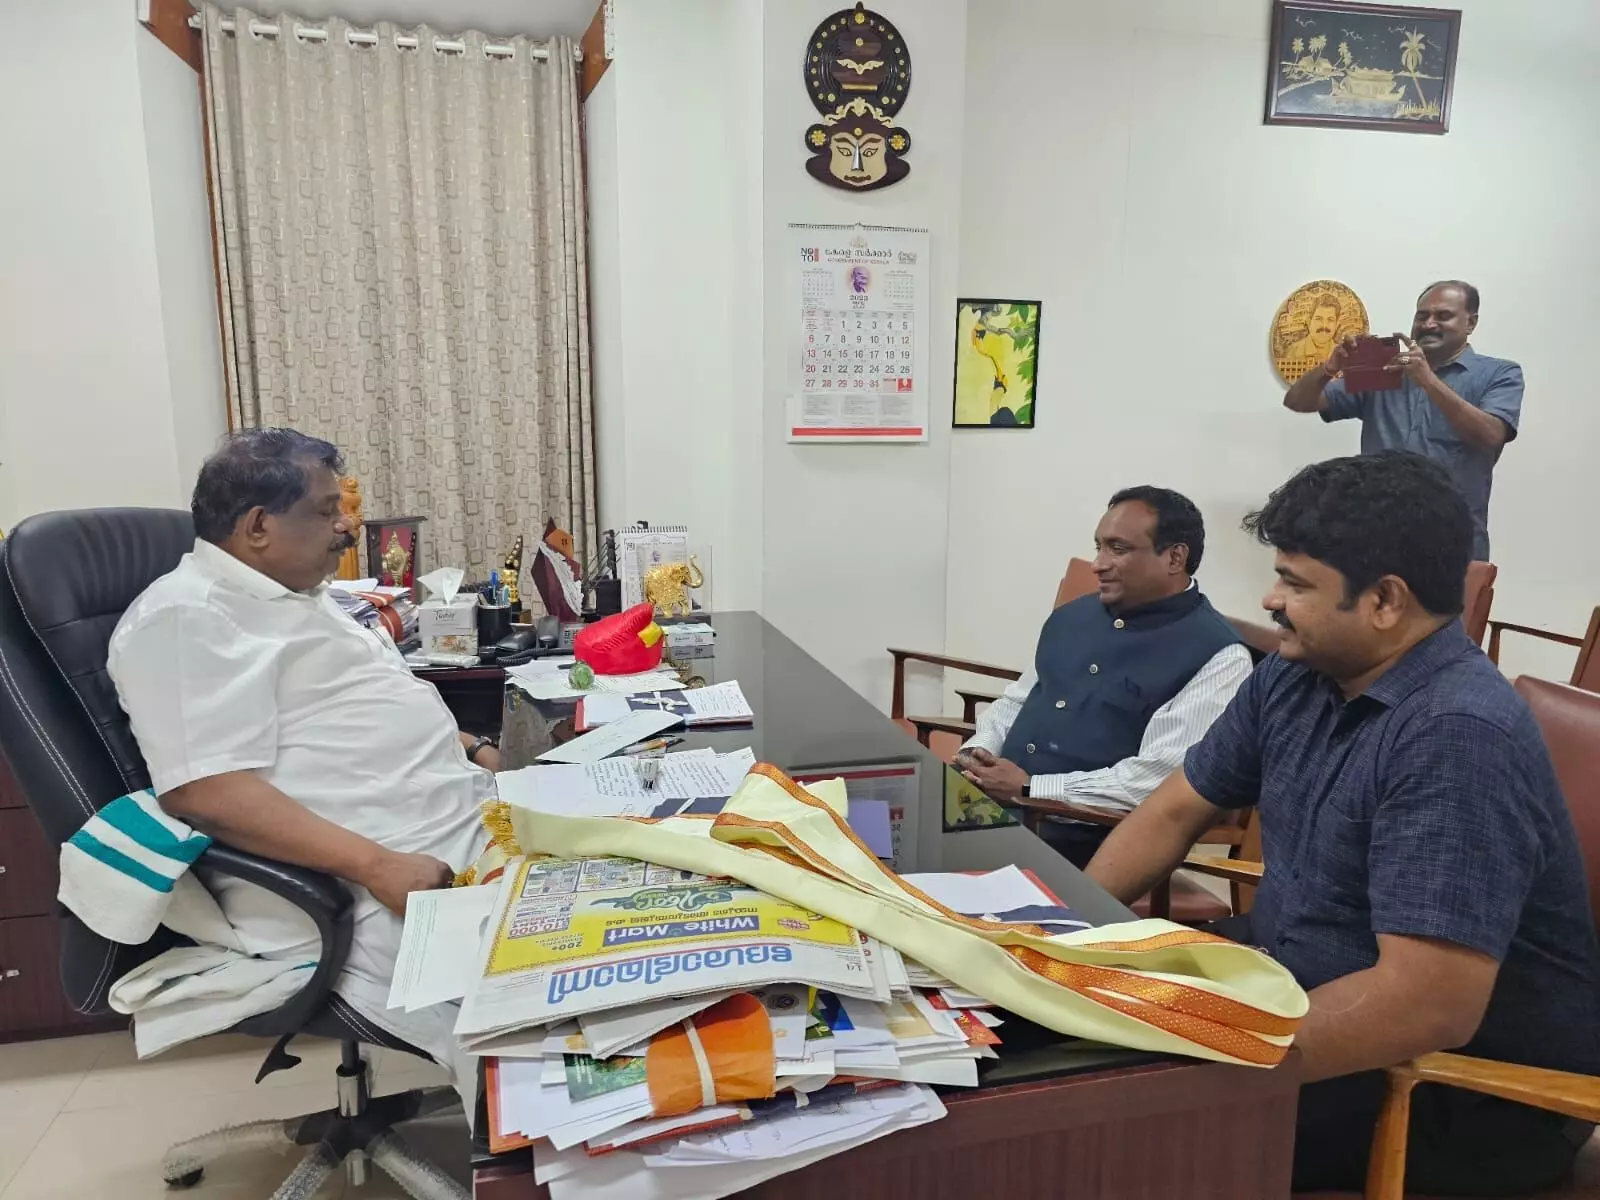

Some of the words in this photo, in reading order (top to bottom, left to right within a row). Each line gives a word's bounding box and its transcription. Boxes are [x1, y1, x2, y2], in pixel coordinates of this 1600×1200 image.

[871, 336, 879, 344] 10
[887, 336, 894, 344] 11
[902, 336, 909, 344] 12
[808, 350, 816, 358] 13
[823, 350, 832, 358] 14
[839, 350, 848, 358] 15
[855, 350, 863, 358] 16
[870, 351, 879, 359] 17
[885, 351, 895, 359] 18
[901, 351, 910, 359] 19
[806, 365, 816, 373] 20
[822, 365, 832, 373] 21
[838, 365, 848, 373] 22
[854, 365, 863, 373] 23
[869, 365, 879, 374] 24
[885, 365, 895, 374] 25
[900, 366, 910, 374] 26
[805, 379, 815, 387] 27
[822, 379, 832, 387] 28
[838, 379, 848, 387] 29
[684, 917, 755, 932] White
[608, 925, 668, 942] Mart
[547, 946, 792, 1004] ദേശാഭിമാനി
